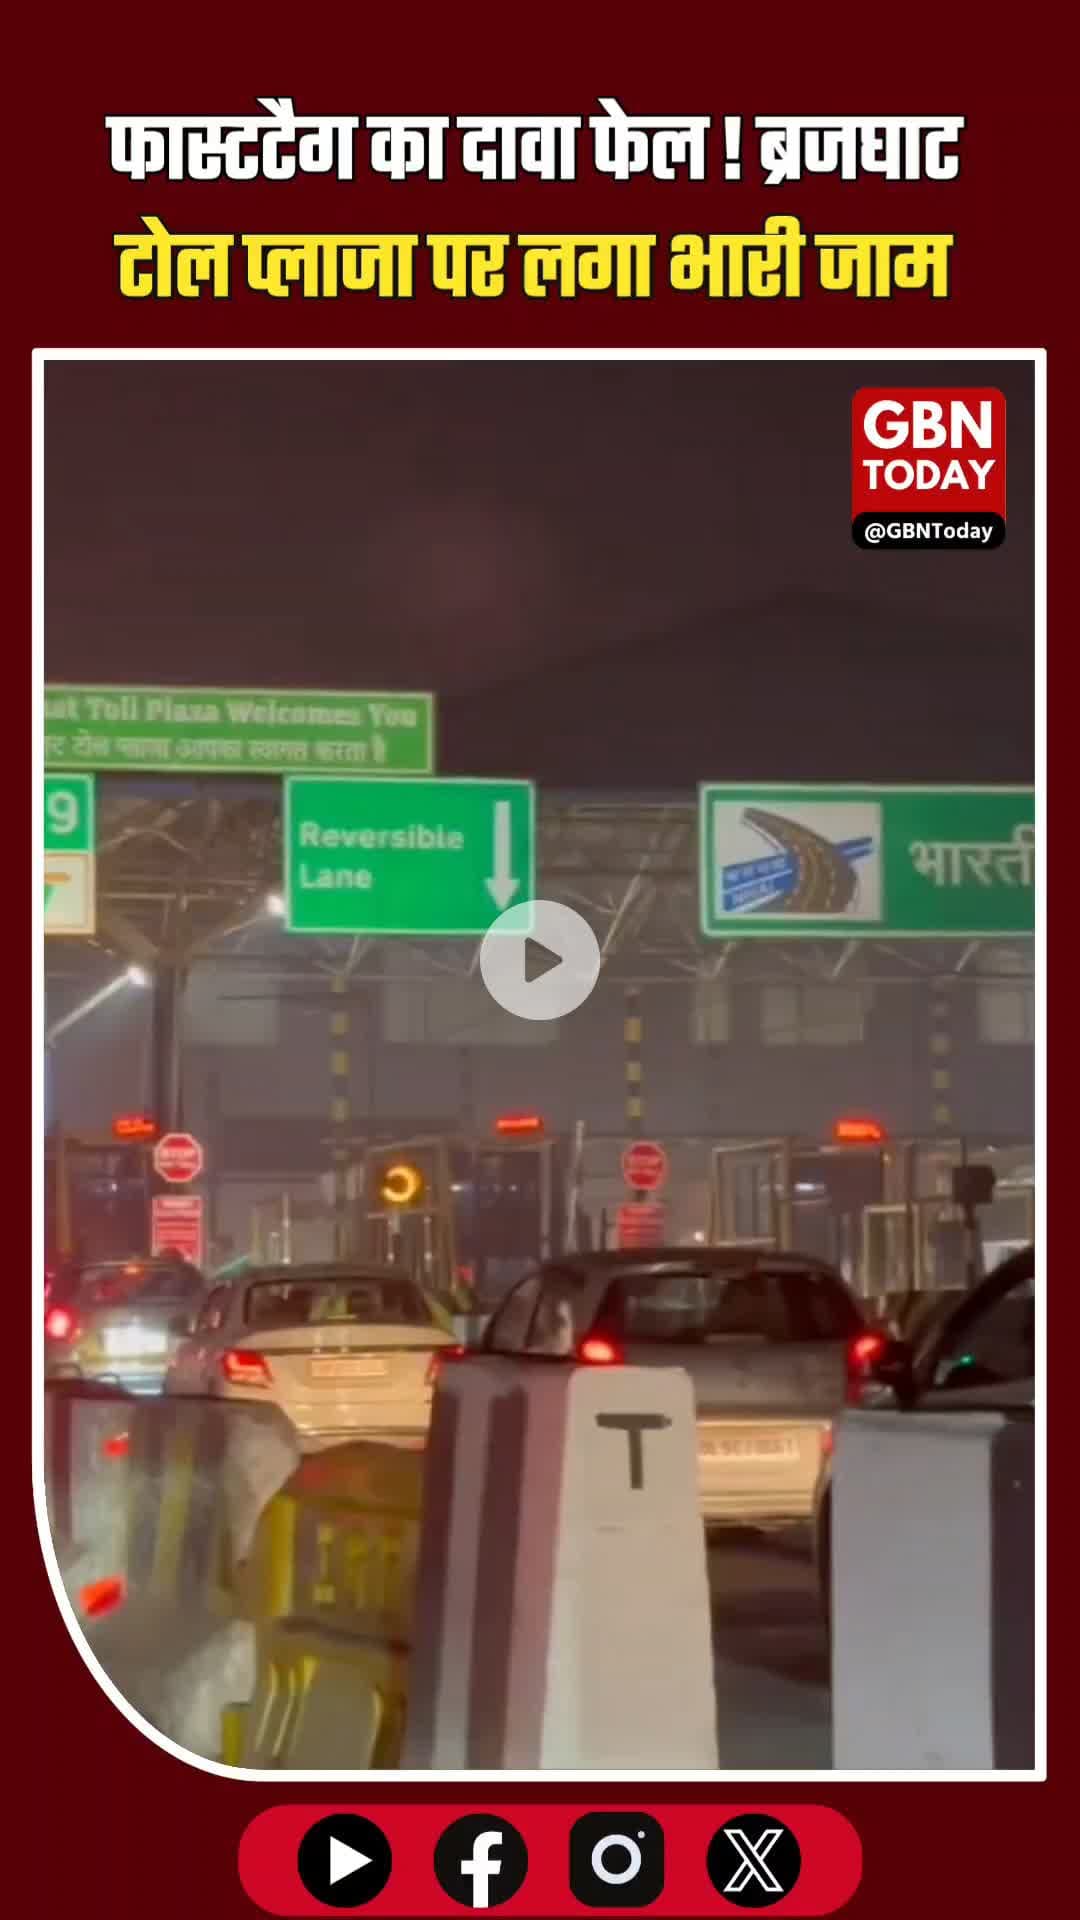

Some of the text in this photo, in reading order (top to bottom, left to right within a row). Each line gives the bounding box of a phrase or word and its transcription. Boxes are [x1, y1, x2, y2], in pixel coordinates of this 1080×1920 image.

[86, 696, 137, 721] Toll
[146, 696, 220, 722] Plaza
[227, 700, 361, 727] Welcomes
[368, 703, 417, 728] You
[47, 791, 79, 834] 9
[300, 821, 465, 850] Reversible
[300, 862, 373, 890] Lane
[595, 1413, 673, 1490] T
